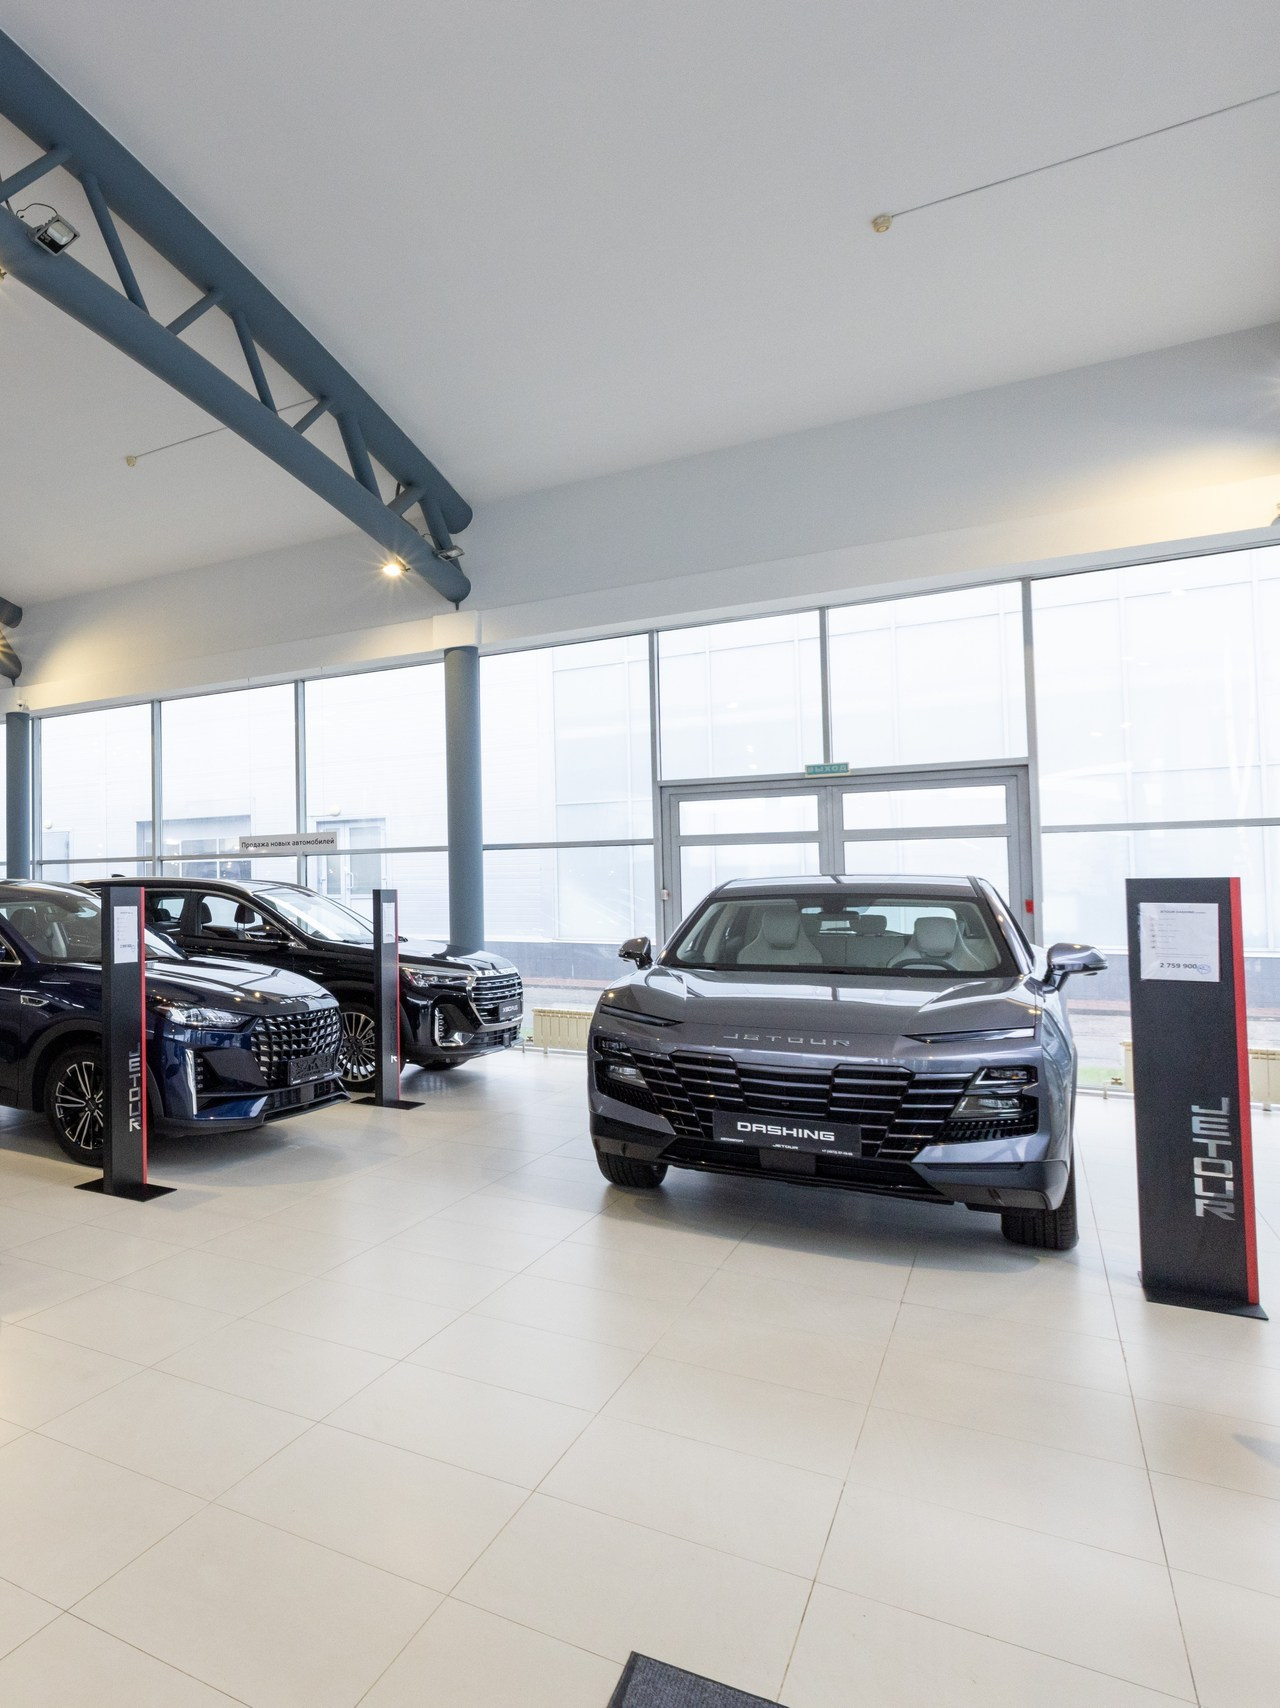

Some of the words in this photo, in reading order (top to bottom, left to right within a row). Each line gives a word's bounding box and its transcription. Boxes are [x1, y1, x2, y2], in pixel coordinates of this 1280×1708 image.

[241, 841, 269, 849] Продажа
[291, 837, 335, 846] автомобилей
[722, 1033, 851, 1047] JETOUR
[128, 1043, 141, 1132] JETOUR
[737, 1121, 835, 1141] DASHING
[1191, 1097, 1236, 1221] JETOUR
